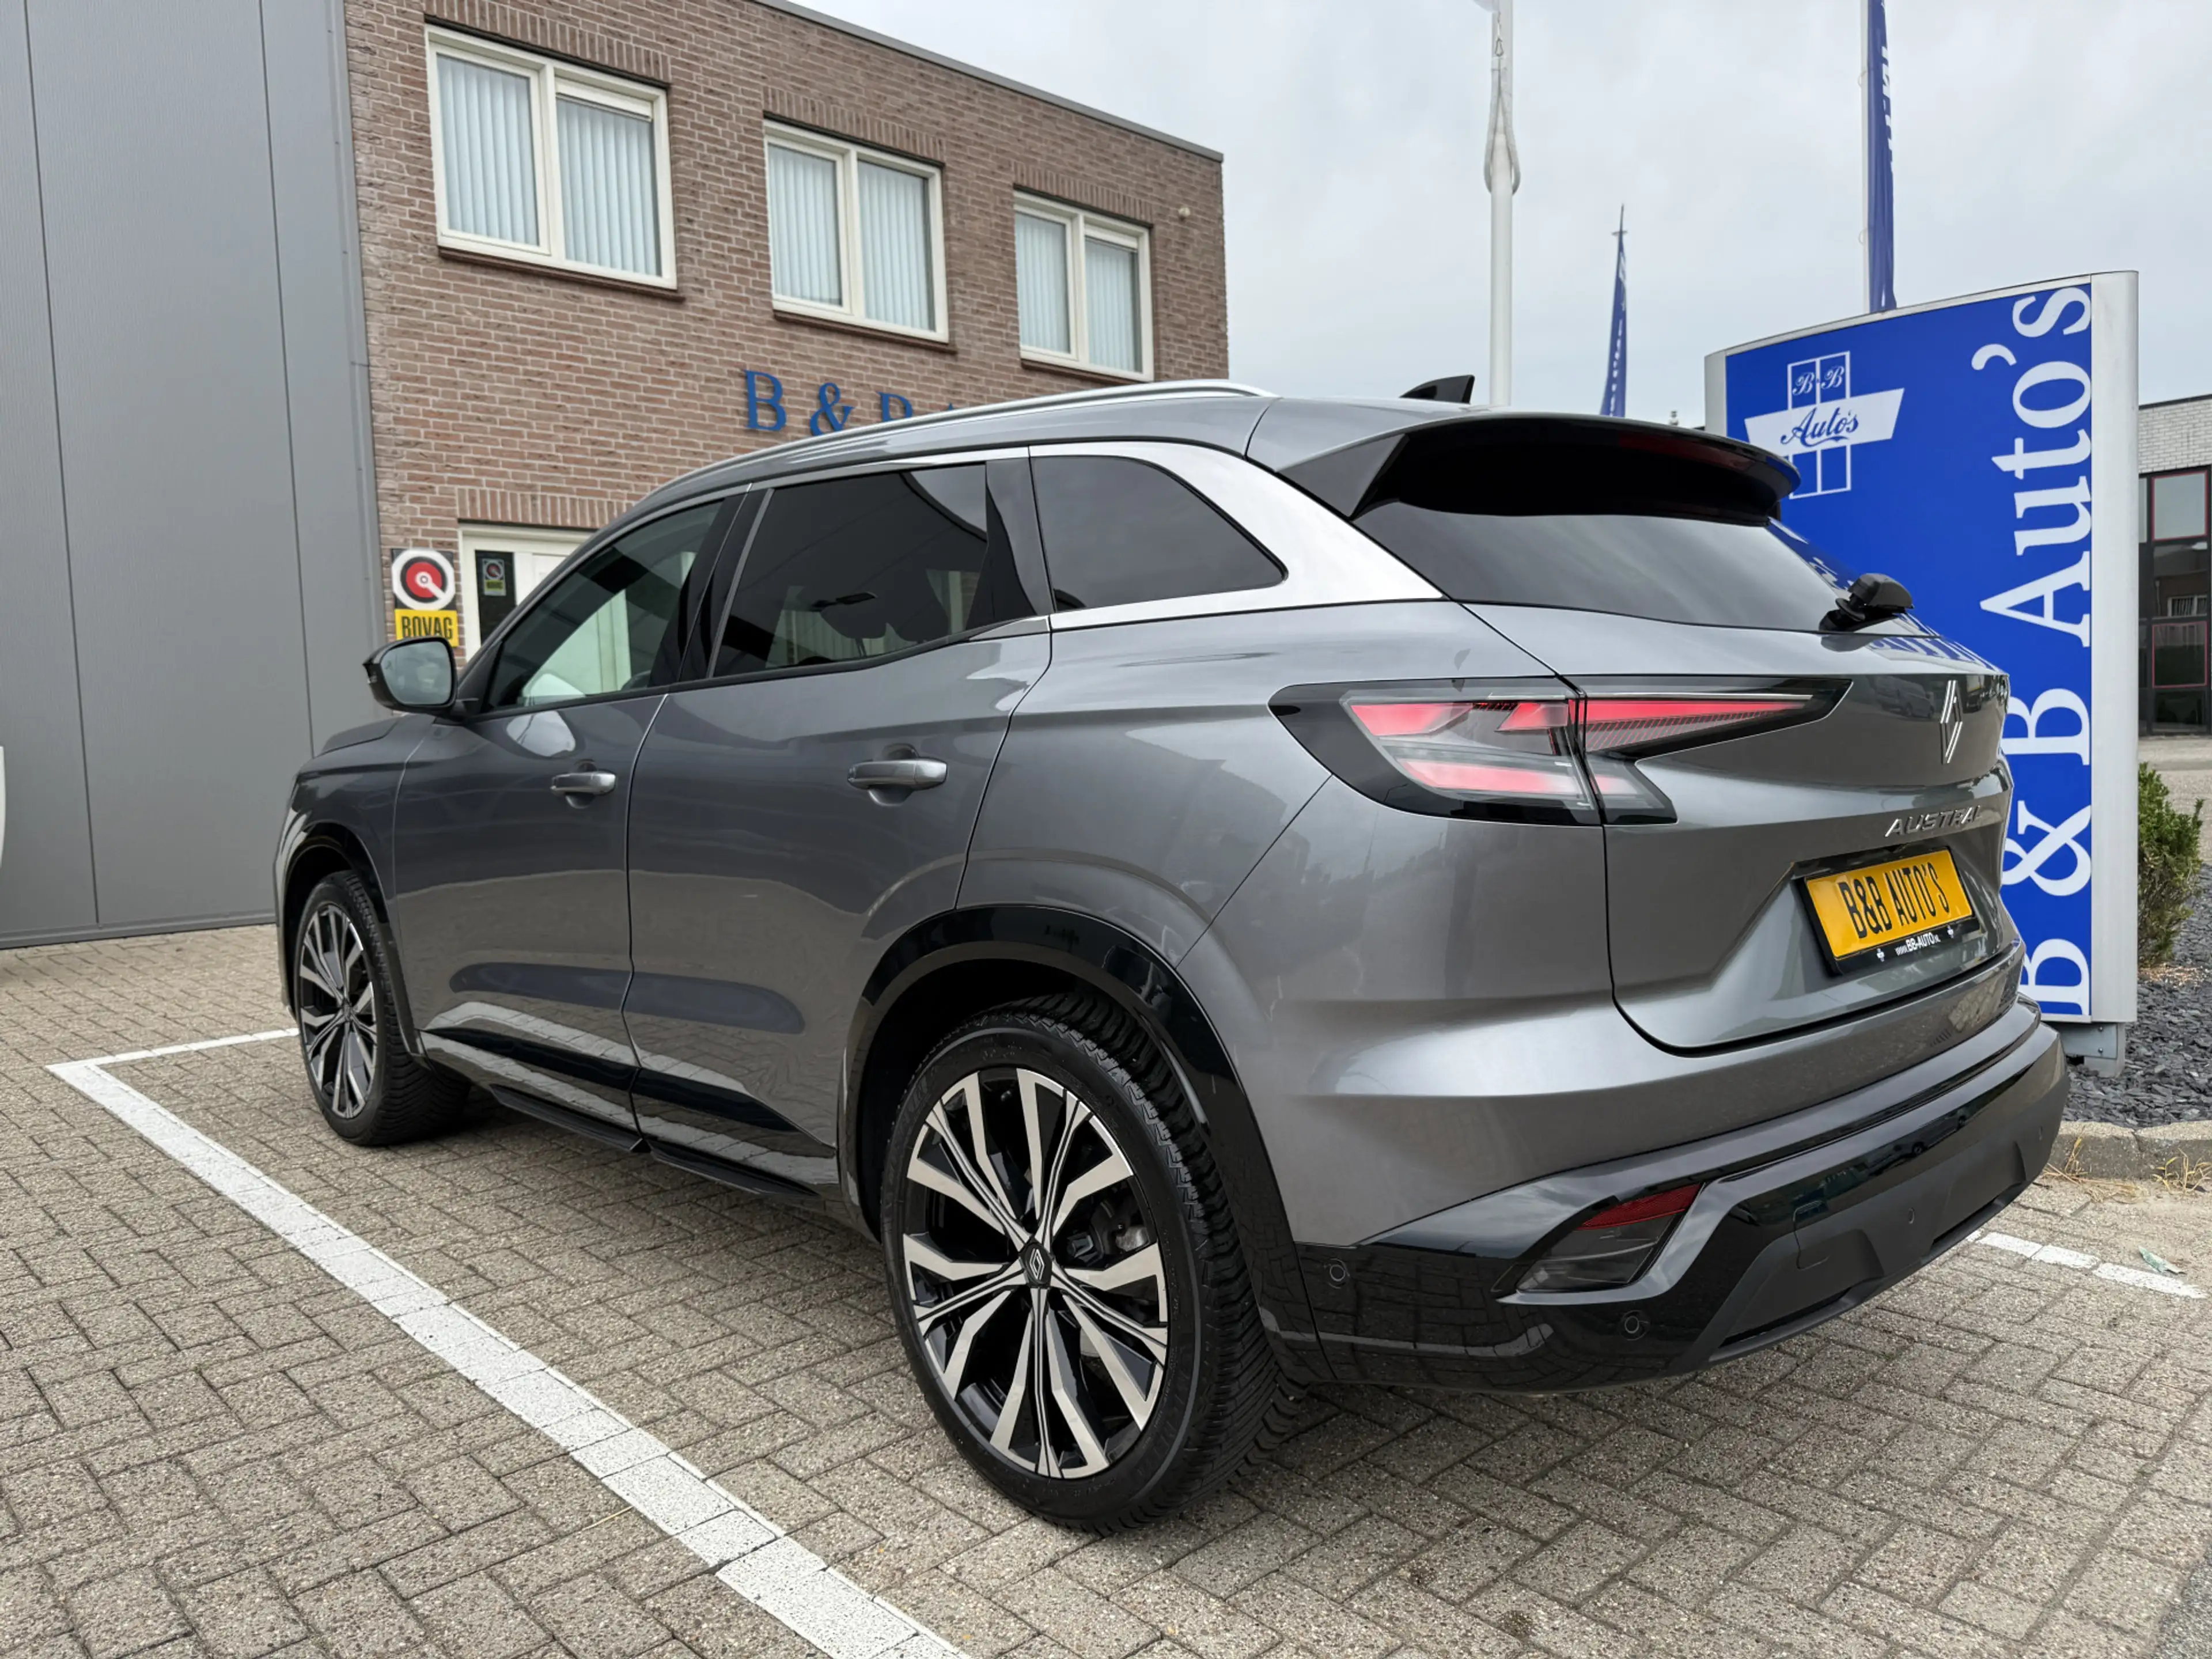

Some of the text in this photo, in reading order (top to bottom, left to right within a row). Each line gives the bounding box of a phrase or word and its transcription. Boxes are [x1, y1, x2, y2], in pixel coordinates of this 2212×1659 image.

[1792, 365, 1844, 396] B B
[745, 369, 786, 431] B
[810, 382, 855, 437] &
[1780, 407, 1859, 448] Auto's
[402, 616, 453, 641] BOVAG
[1971, 287, 2092, 1016] B & B Auto's
[1884, 805, 1983, 837] AUSTRAL
[1837, 862, 1950, 939] B&B AUTO'S
